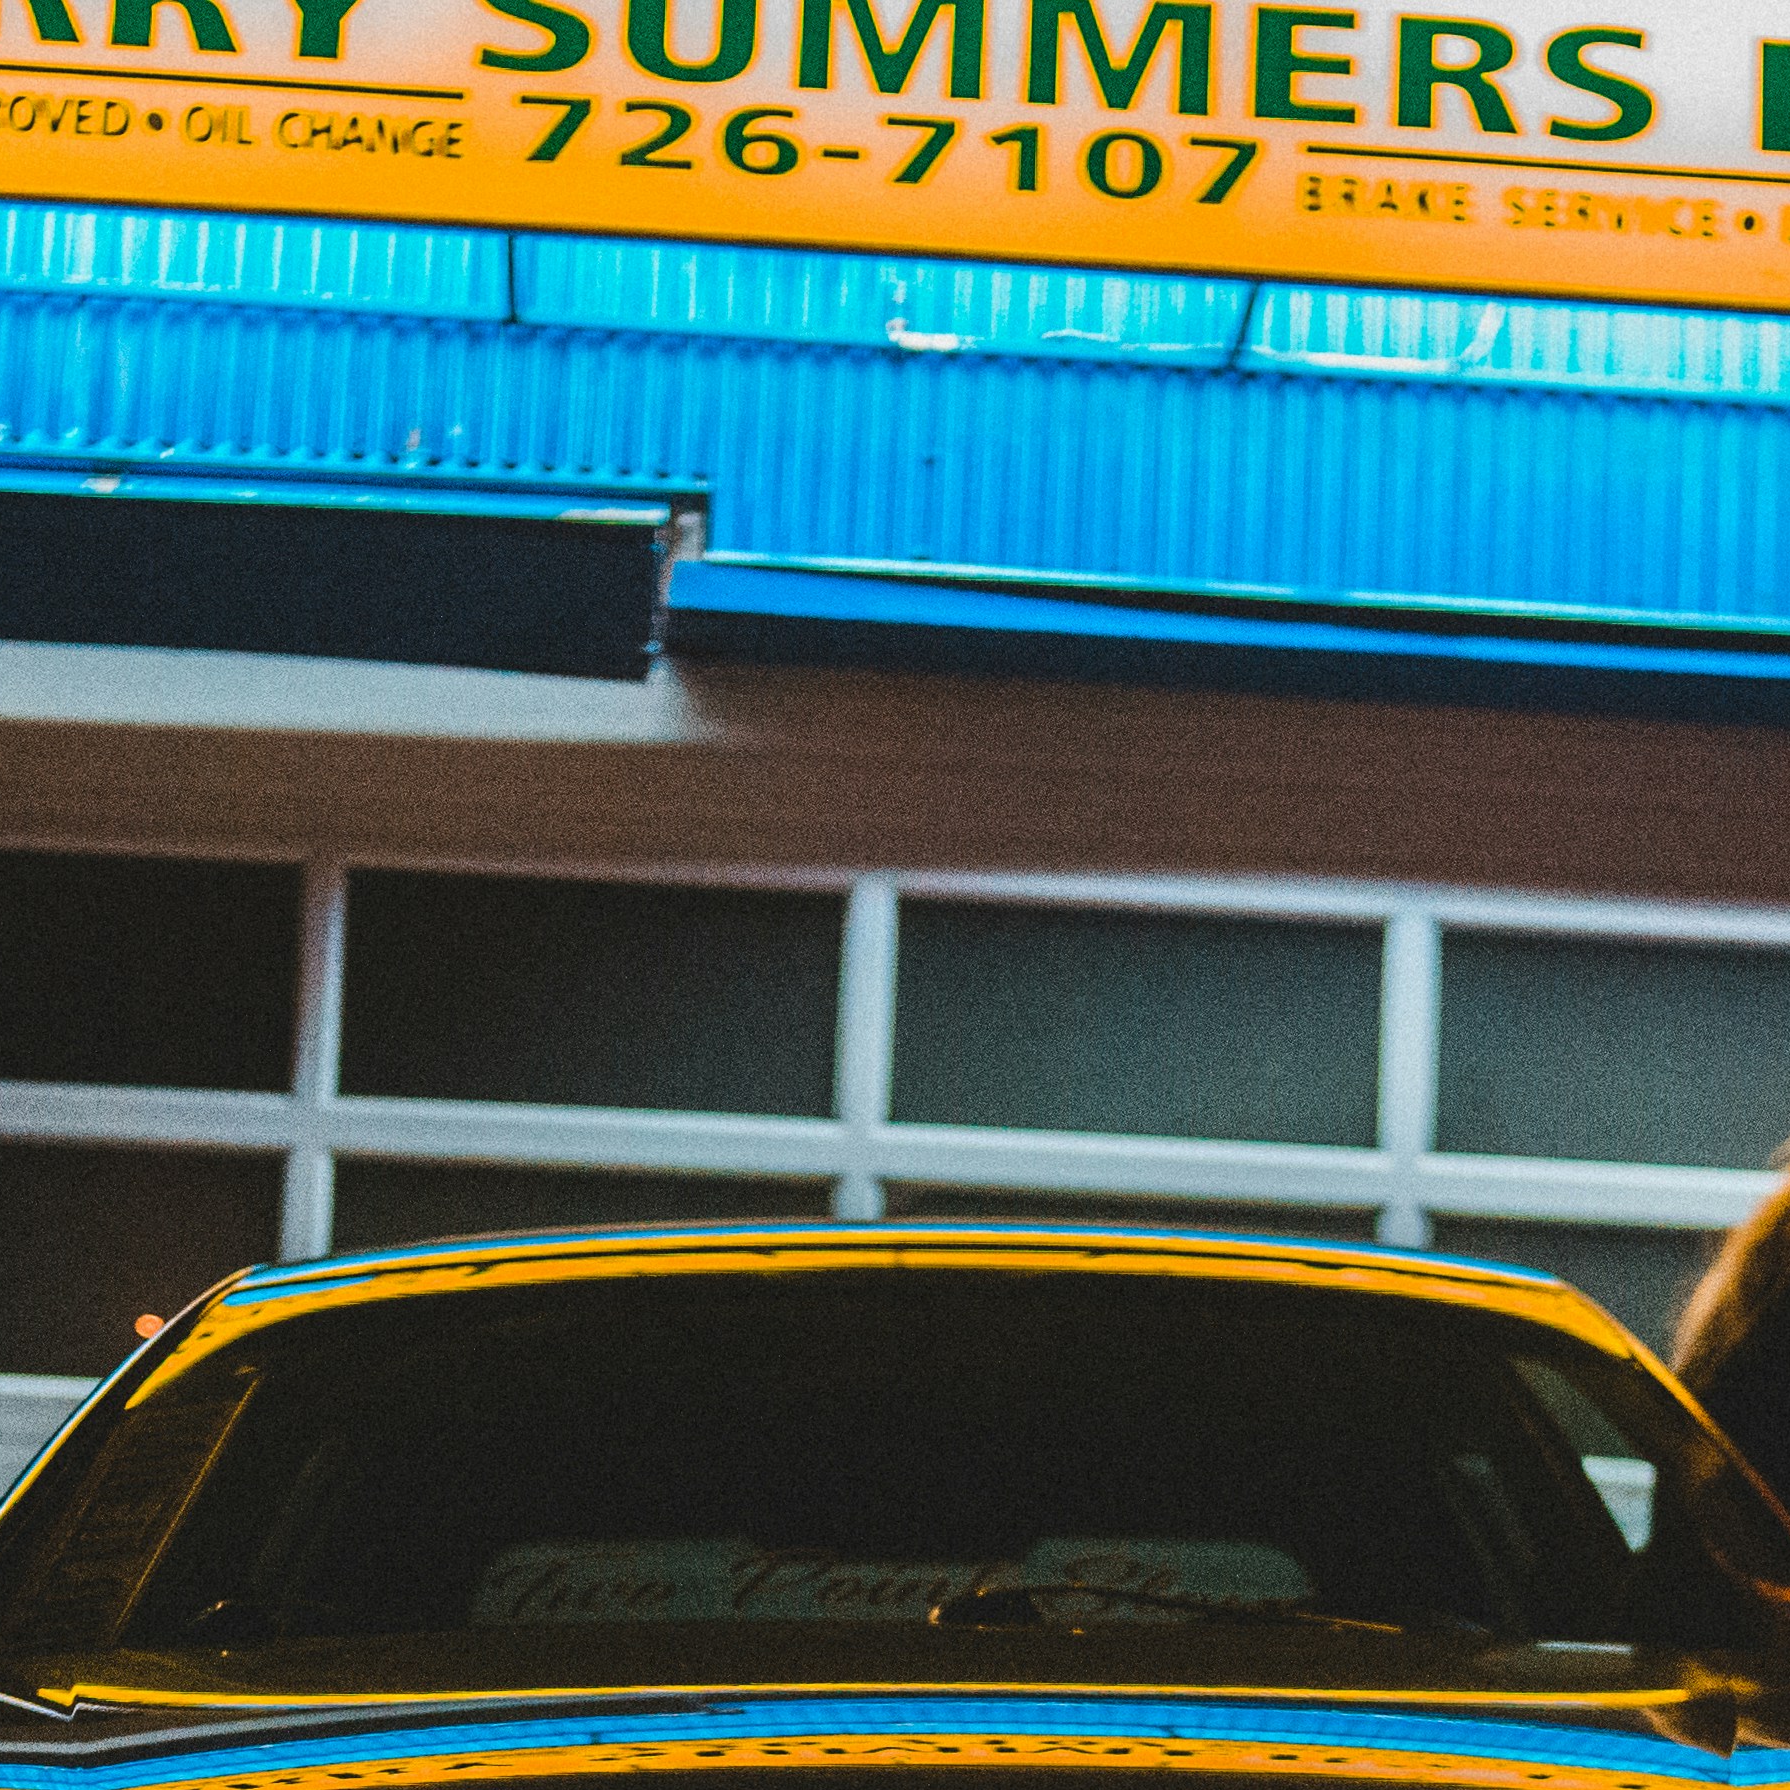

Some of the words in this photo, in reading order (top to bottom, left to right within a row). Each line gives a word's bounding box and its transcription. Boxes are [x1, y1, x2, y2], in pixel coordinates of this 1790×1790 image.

[474, 0, 1654, 143] SUMMERS
[185, 105, 254, 146] OIL
[278, 111, 464, 160] CHANGE
[518, 94, 1258, 205] 726-7107
[1302, 174, 1469, 223] BRAKE
[1508, 187, 1715, 239] SERVICE
